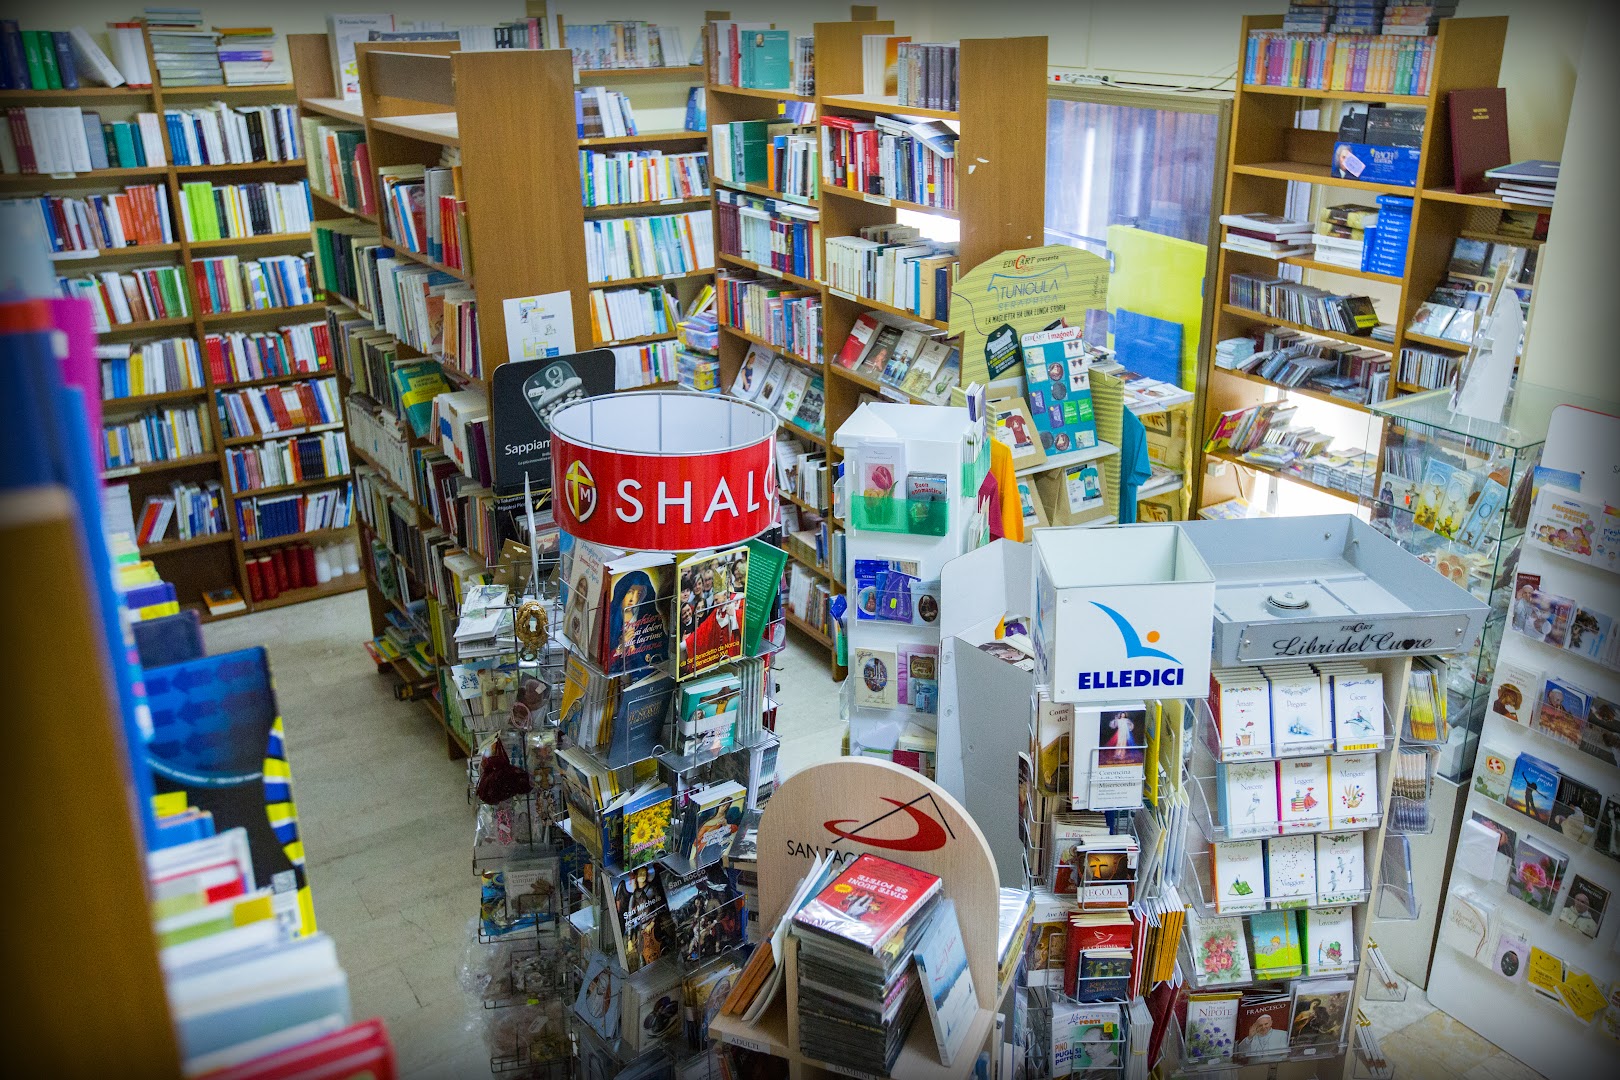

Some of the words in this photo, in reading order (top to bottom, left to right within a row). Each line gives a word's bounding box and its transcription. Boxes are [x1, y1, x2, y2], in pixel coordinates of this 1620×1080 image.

[1051, 329, 1074, 341] magneti
[1273, 636, 1335, 656] Libri
[1336, 634, 1370, 653] del
[1078, 668, 1185, 690] ELLEDICI
[1048, 708, 1069, 716] Come
[1057, 715, 1068, 723] del
[787, 840, 819, 859] SAN
[847, 877, 877, 891] BUONI
[857, 874, 894, 890] POTETE
[877, 886, 909, 901] STATE
[894, 885, 909, 894] SE
[1199, 1008, 1233, 1017] NIPOTE
[1246, 1003, 1286, 1015] FRANCESCO
[731, 1036, 759, 1050] ADULTI
[1055, 1048, 1082, 1059] PUGLSI
